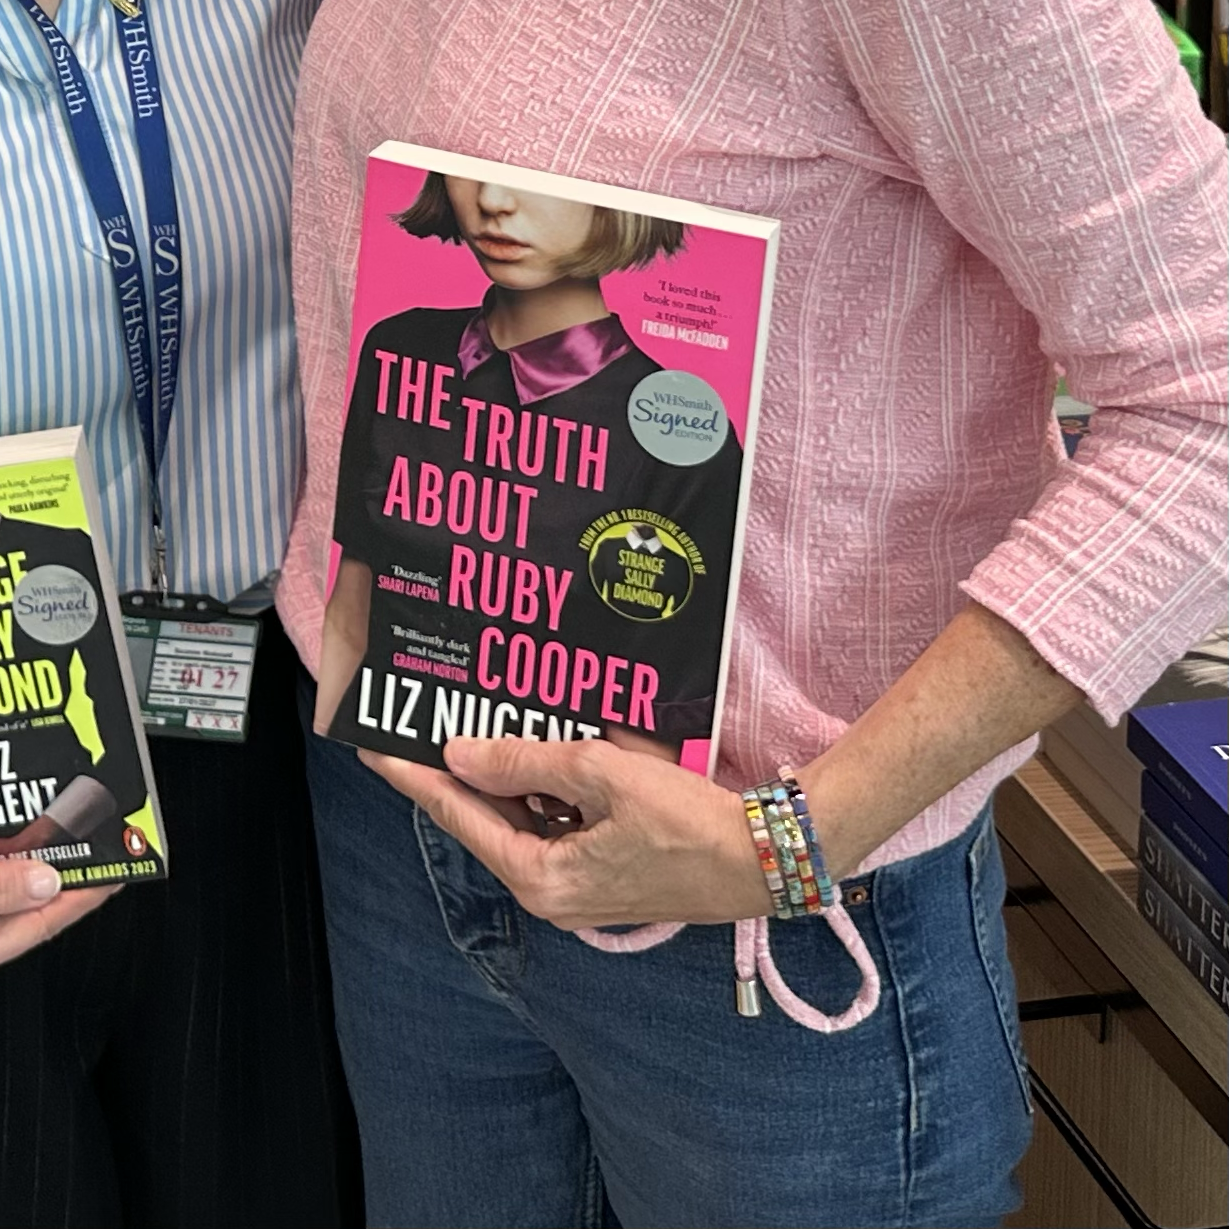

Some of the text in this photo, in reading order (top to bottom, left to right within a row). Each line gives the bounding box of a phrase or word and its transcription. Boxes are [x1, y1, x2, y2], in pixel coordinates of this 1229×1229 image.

[29, 4, 87, 116] WHSmith
[643, 291, 684, 309] book so
[668, 282, 698, 298] loved
[699, 289, 721, 302] this
[655, 311, 663, 320] a
[119, 274, 151, 400] WHSmith
[158, 284, 179, 411] WHSmith
[373, 347, 456, 431] THE
[653, 391, 713, 411] WHSmith
[633, 398, 719, 436] Signed
[460, 395, 611, 493] TRUTH
[673, 429, 713, 442] EDITION
[382, 454, 539, 550] ABOUT
[578, 526, 599, 552] FROM
[591, 515, 610, 533] THE
[627, 508, 682, 537] BESTSELLING
[676, 531, 703, 564] AUTHOR
[617, 549, 666, 576] STRANGE
[377, 574, 441, 603] SHARI LAPENA
[447, 543, 574, 633] RUBY
[624, 568, 657, 590] SALLY
[18, 592, 90, 623] Signed
[613, 582, 665, 609] DIAMOND
[178, 621, 234, 638] TENANTS
[406, 644, 427, 657] and
[446, 637, 471, 654] dark
[211, 670, 240, 691] 27
[392, 651, 469, 684] GRAHAM NORTON
[476, 626, 660, 732] COOPER
[357, 666, 423, 740] LIZ
[30, 842, 92, 862] BESTSELLER
[86, 862, 130, 881] AWARDS
[130, 859, 158, 876] 2023
